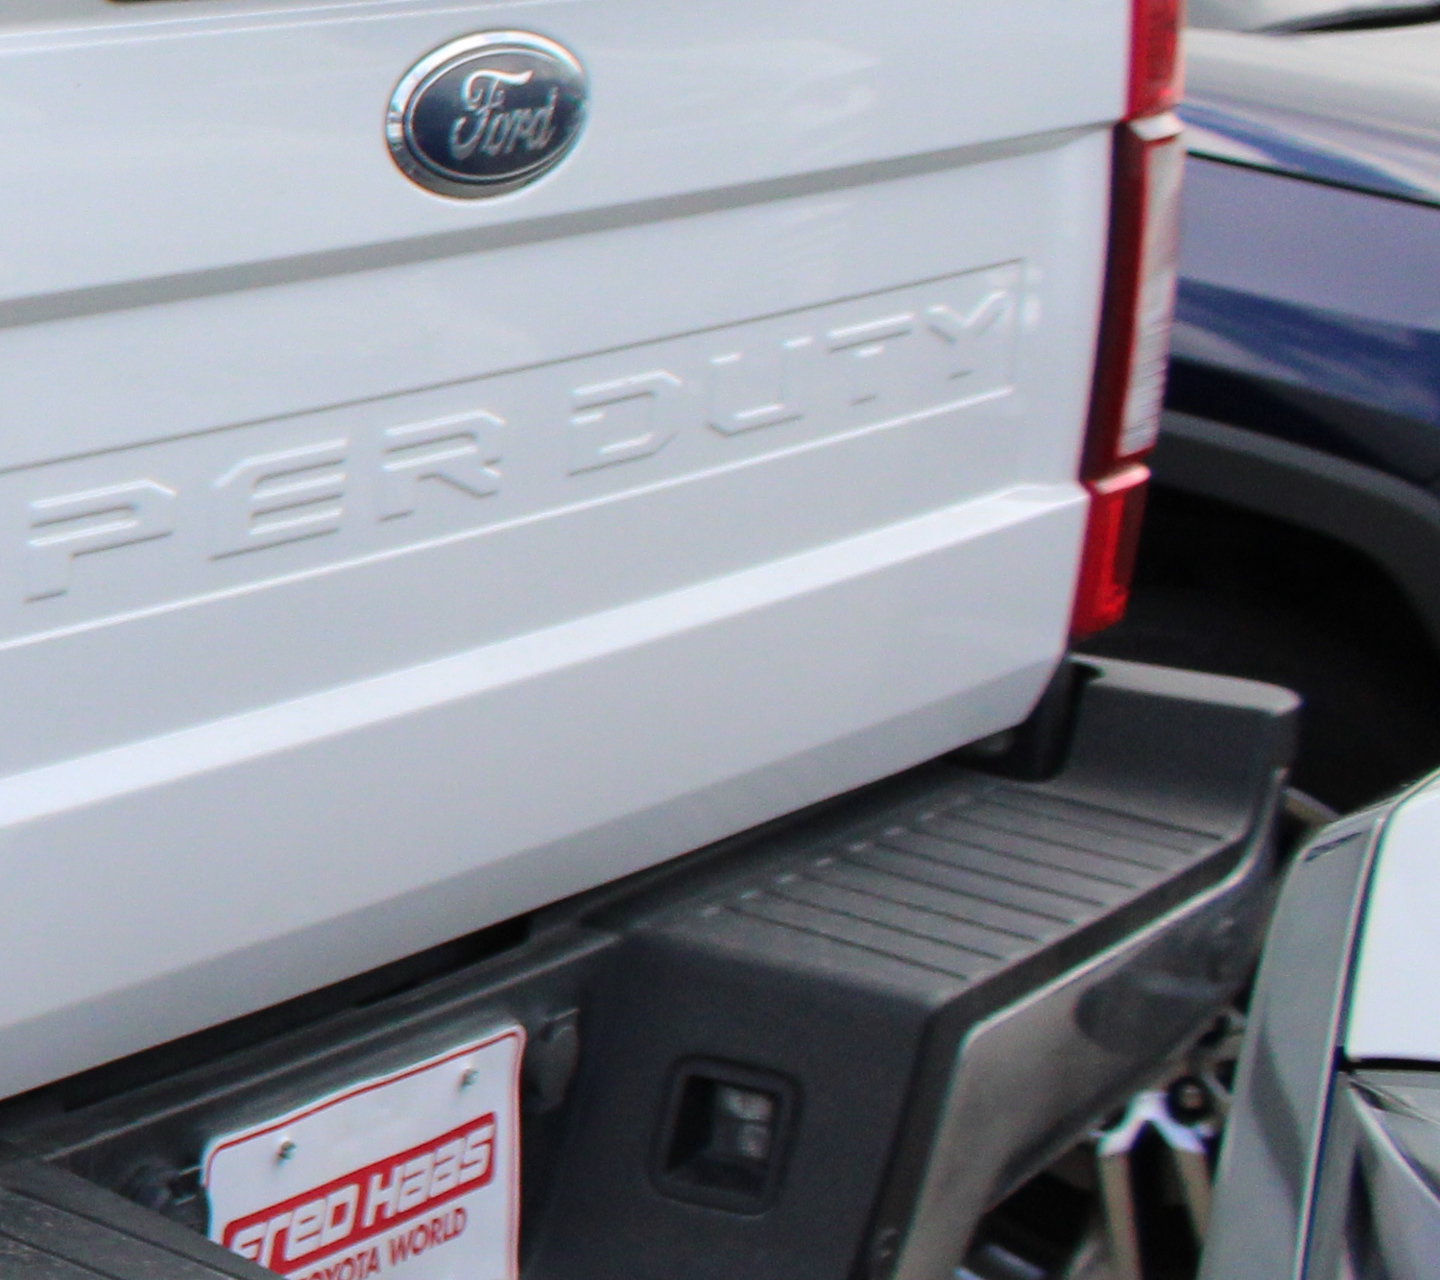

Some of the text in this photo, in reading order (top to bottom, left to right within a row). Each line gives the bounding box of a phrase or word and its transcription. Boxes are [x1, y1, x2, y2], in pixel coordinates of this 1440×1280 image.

[448, 69, 559, 161] Ford
[566, 288, 1009, 477] DUTY
[389, 1207, 467, 1267] WORLD
